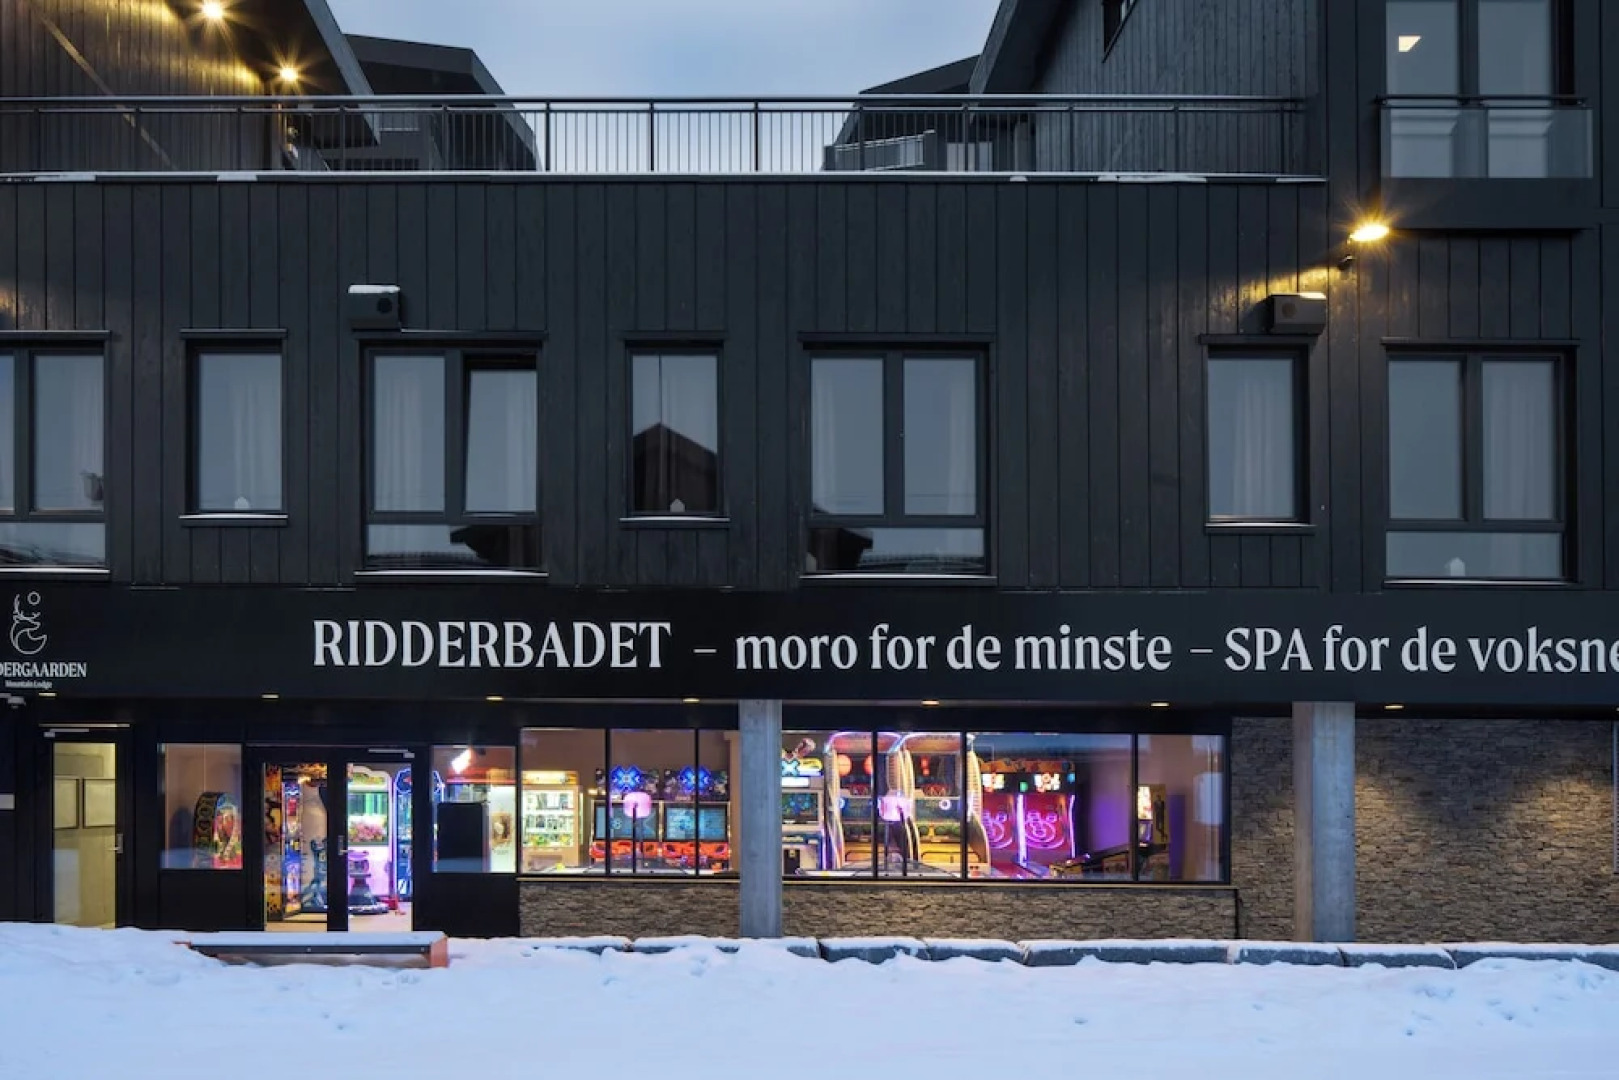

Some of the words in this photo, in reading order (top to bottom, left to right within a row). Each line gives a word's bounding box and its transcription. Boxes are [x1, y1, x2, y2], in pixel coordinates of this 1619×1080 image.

[314, 621, 671, 668] RIDDERBADET
[736, 635, 858, 670] moro
[869, 623, 936, 670] for
[946, 624, 1001, 670] de
[1014, 624, 1172, 671] minste
[1224, 627, 1314, 671] SPA
[1322, 624, 1390, 672] for
[1401, 626, 1457, 673] de
